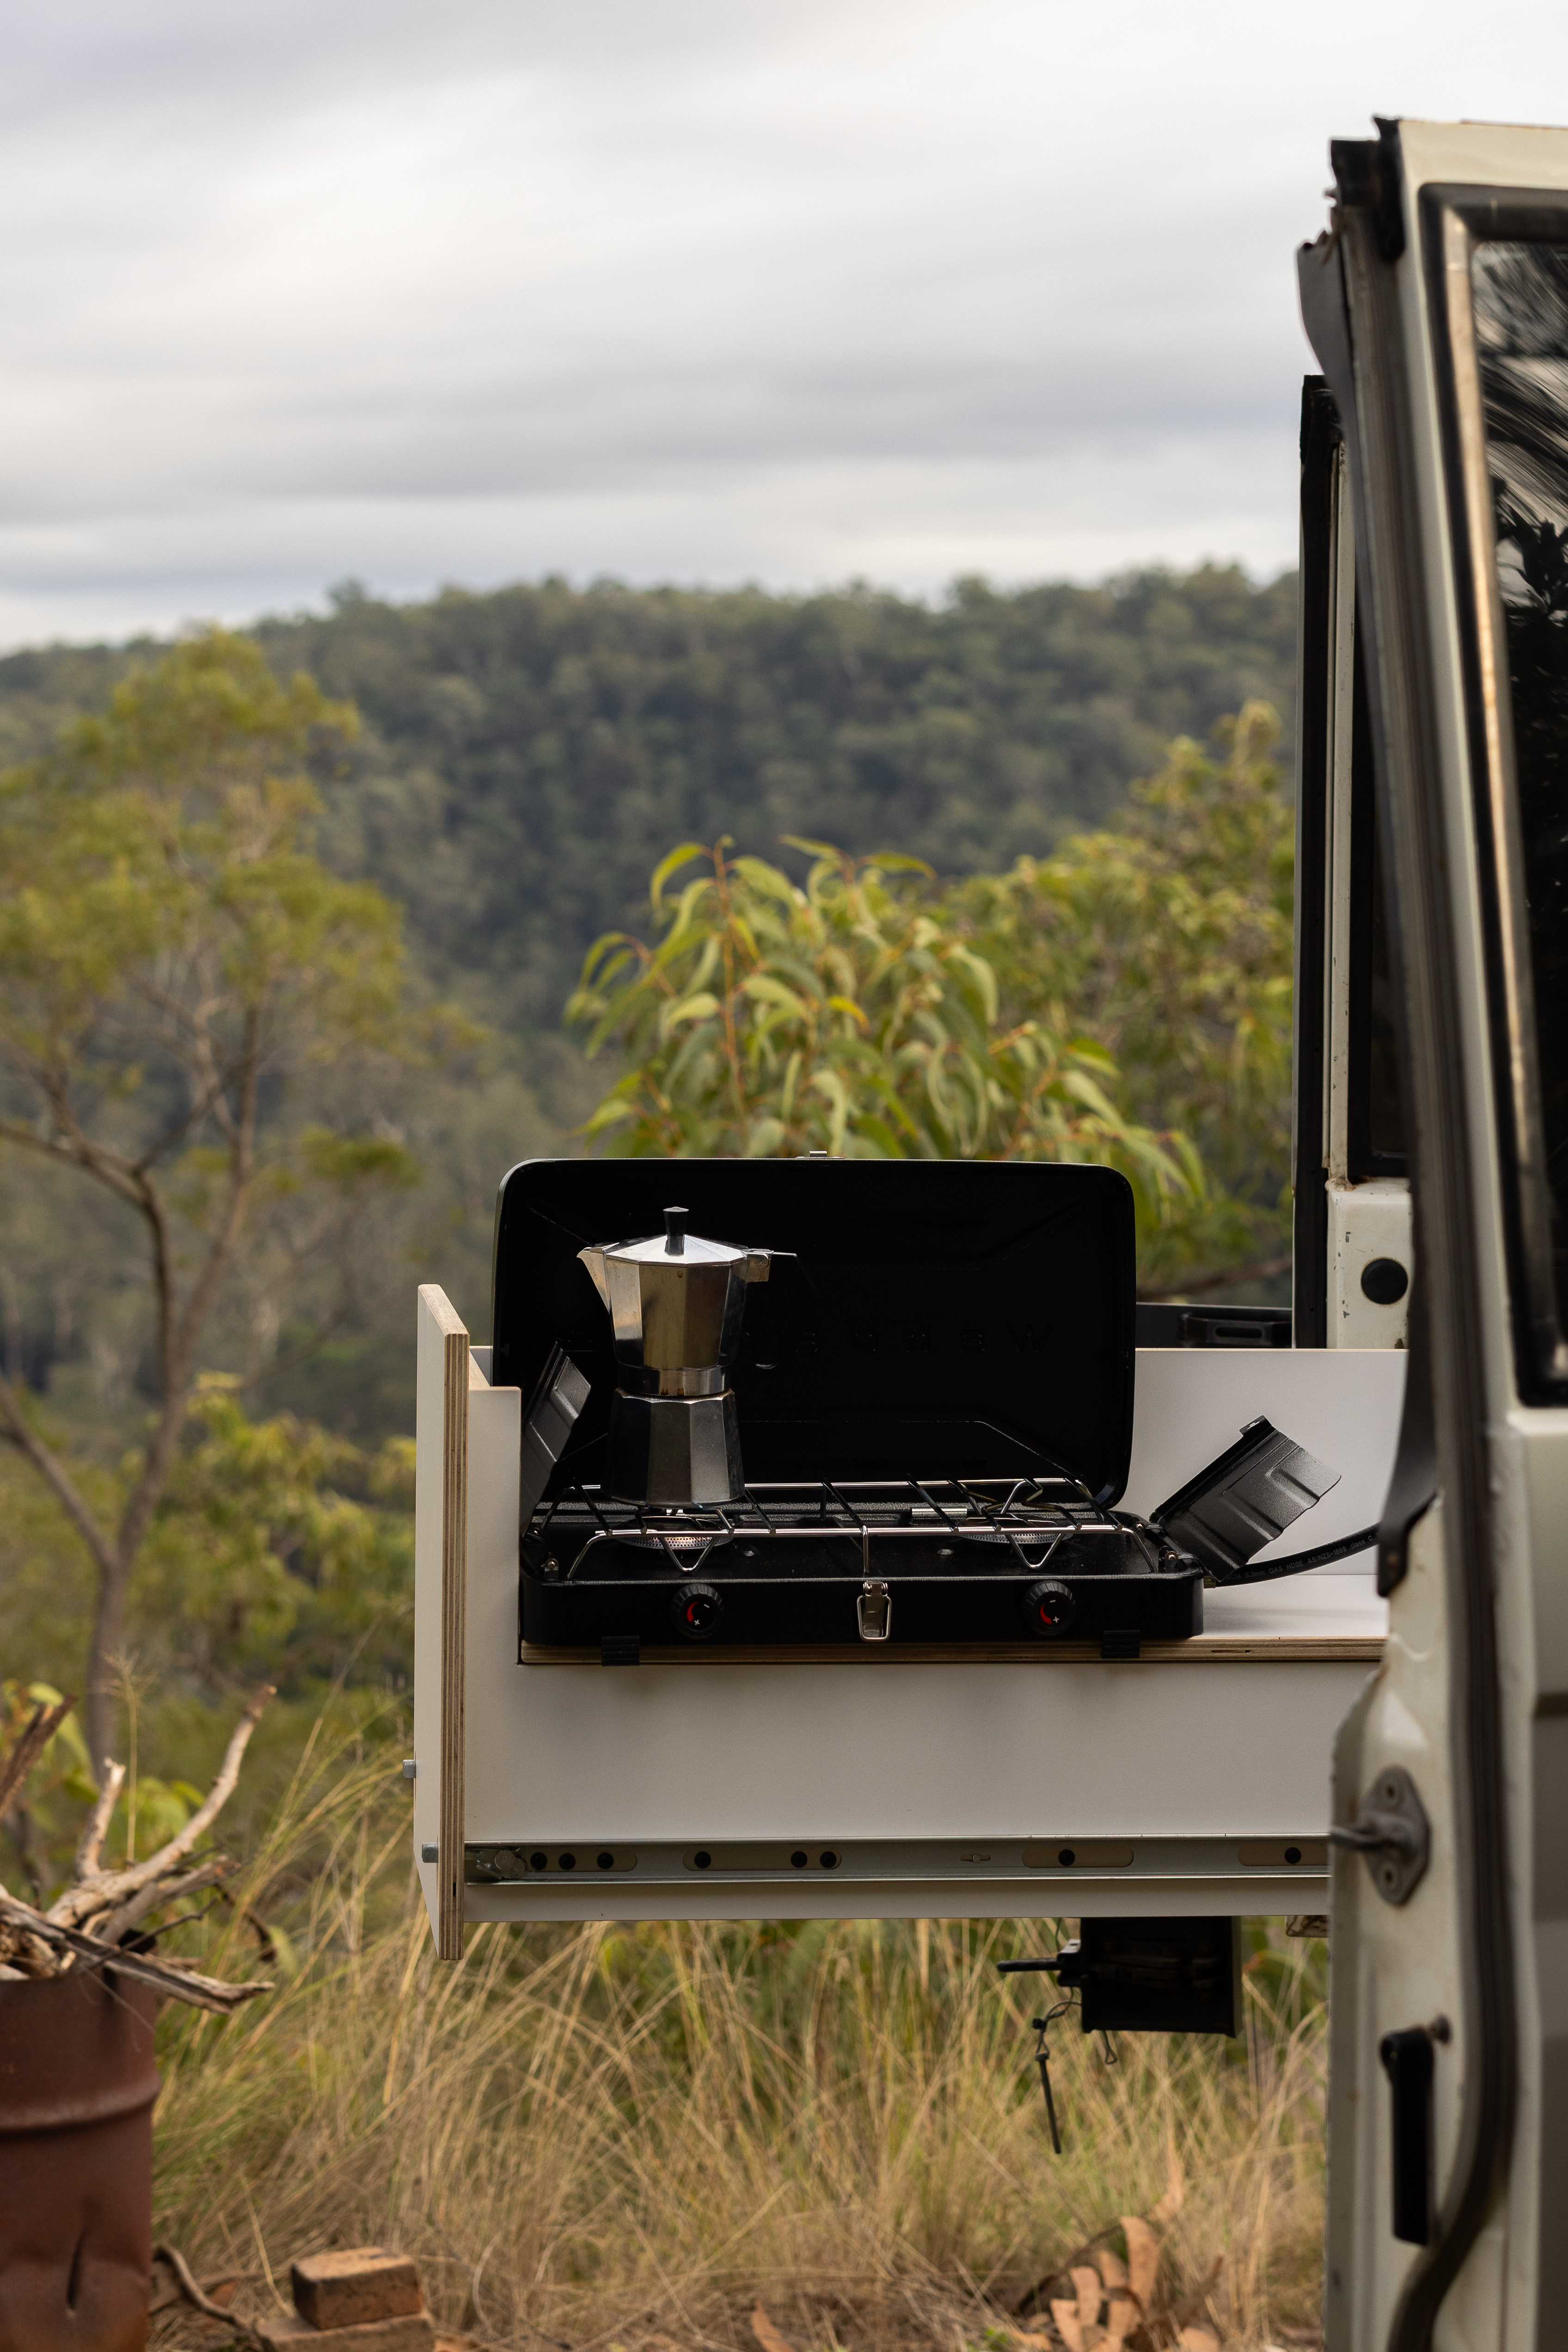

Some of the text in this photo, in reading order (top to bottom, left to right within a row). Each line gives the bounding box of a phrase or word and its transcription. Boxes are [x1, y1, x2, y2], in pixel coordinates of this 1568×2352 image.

[1286, 1560, 1304, 1570] HOSE
[1308, 1546, 1347, 1564] AS/NZS-1869
[1350, 1540, 1365, 1549] class
